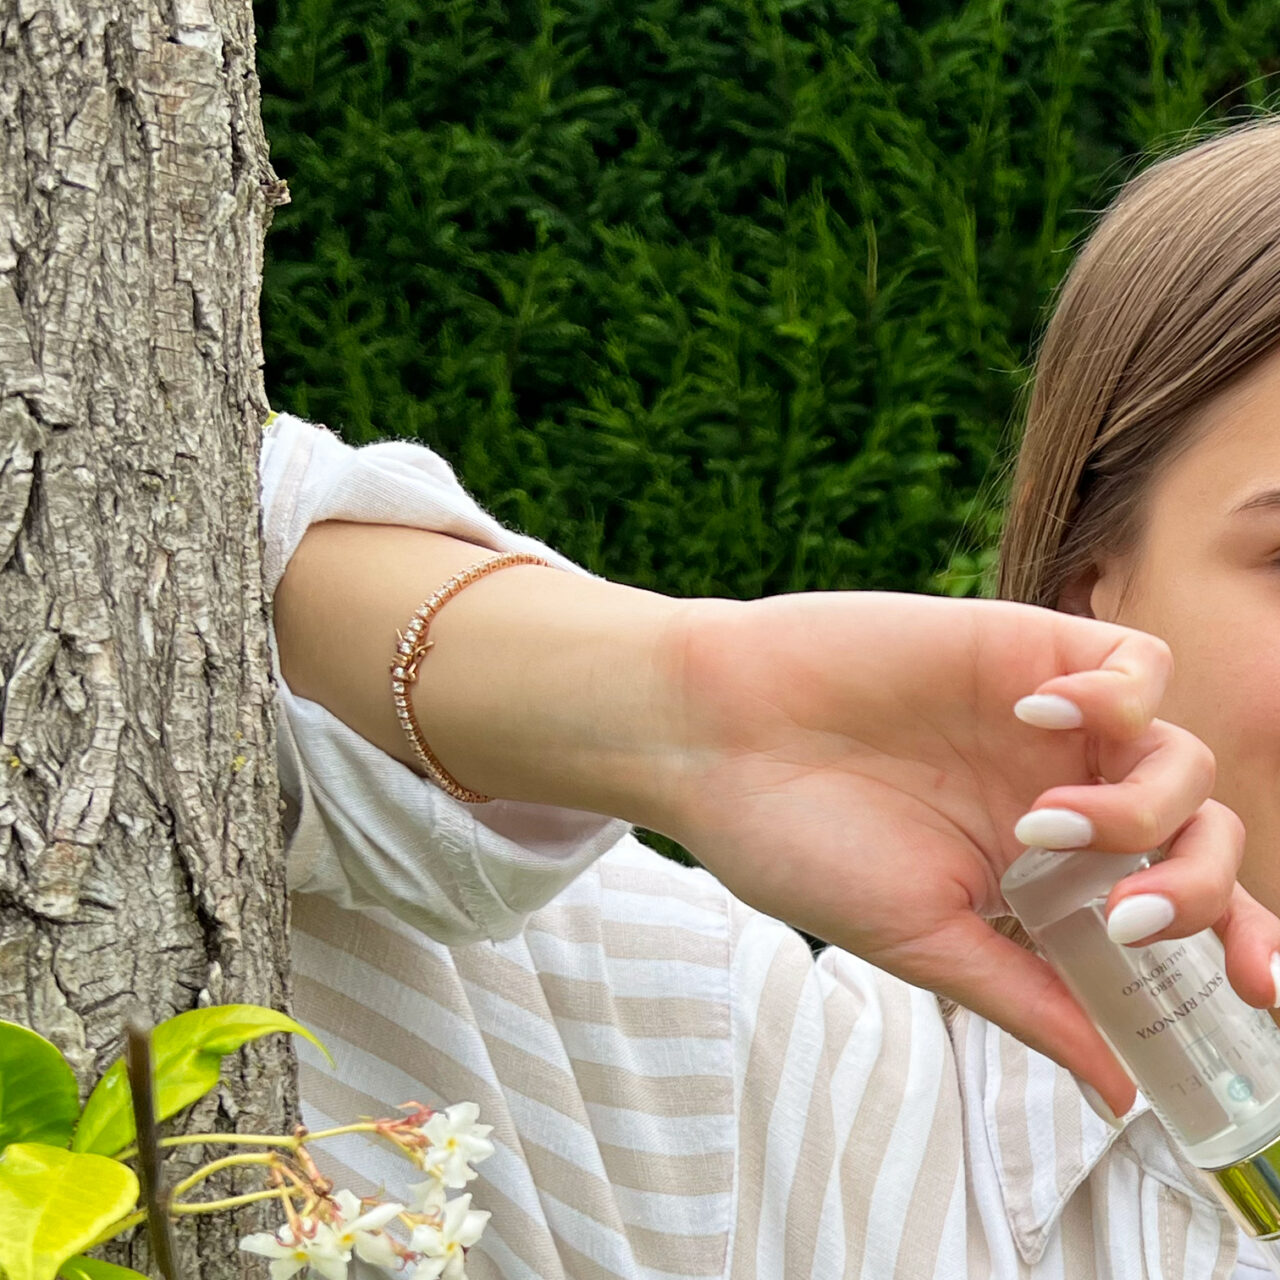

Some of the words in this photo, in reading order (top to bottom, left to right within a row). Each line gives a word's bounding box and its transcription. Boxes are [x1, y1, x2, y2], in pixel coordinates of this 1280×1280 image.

[1122, 943, 1187, 996] JALURONICO
[1150, 969, 1182, 997] SIERO
[1198, 971, 1224, 1002] SKIN
[1136, 997, 1198, 1039] RINNOVA
